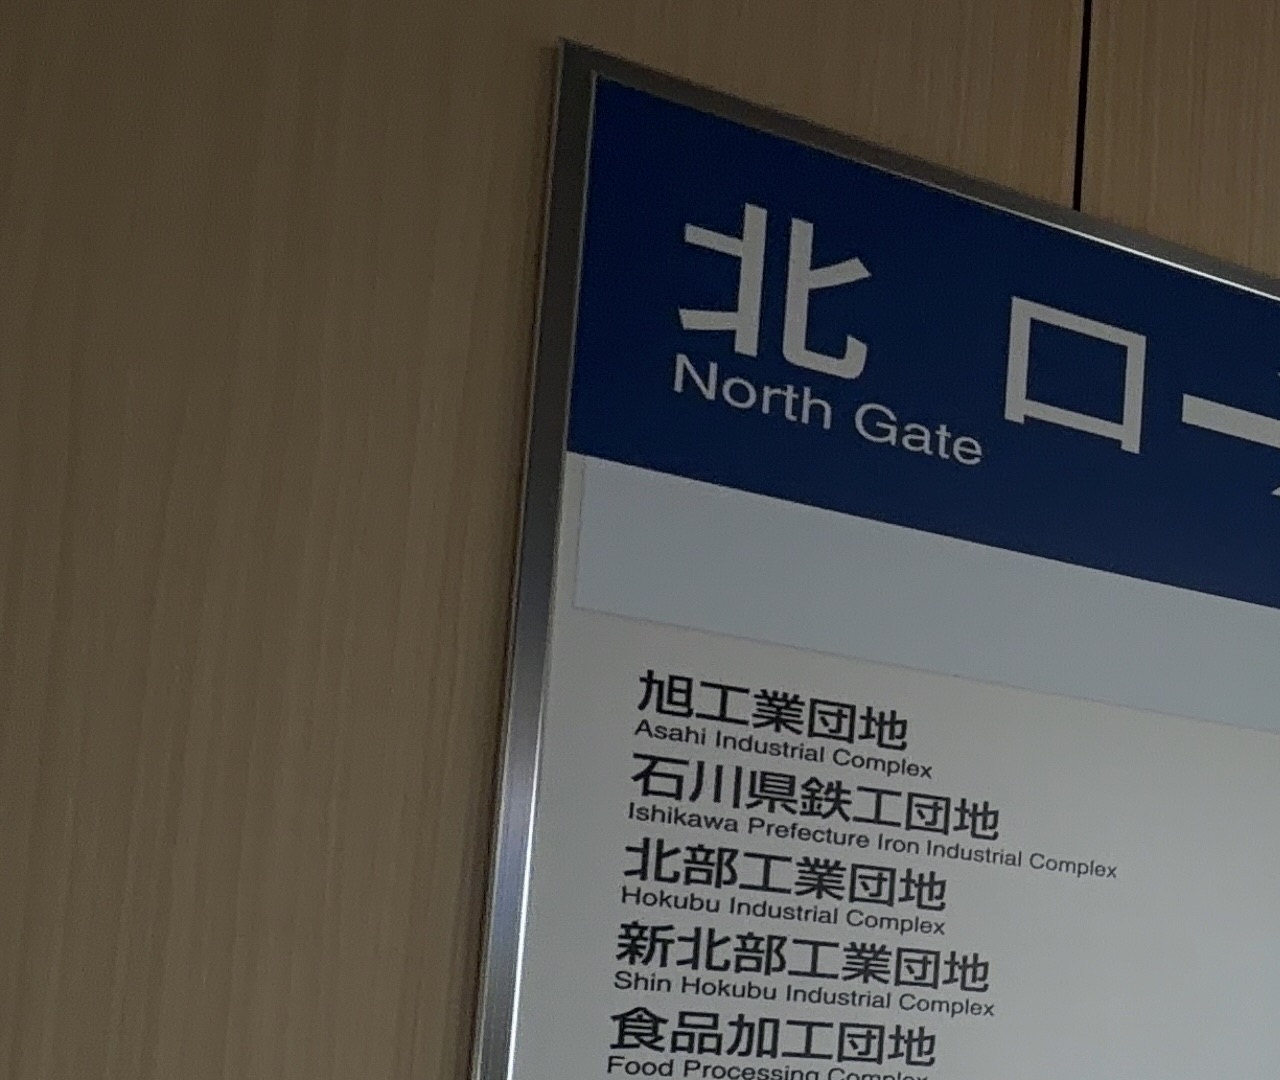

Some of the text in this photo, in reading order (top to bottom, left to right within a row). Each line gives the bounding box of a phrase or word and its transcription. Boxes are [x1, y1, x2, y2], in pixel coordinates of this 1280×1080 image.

[674, 353, 982, 465] North Gate
[637, 669, 908, 752] 旭工業団地
[634, 718, 933, 780] Asahi Industrial Complex
[630, 752, 999, 841] 石川県鉄工団地
[623, 836, 947, 912] 北部工業団地
[628, 801, 1117, 879] Ishikawa Prefecture Iron Industrial Complex
[621, 885, 945, 936] Hokubu Industrial Complex
[615, 920, 989, 993] 新北部工業団地
[613, 970, 995, 1019] Shin Hokubu Industrial Complex
[606, 1055, 675, 1077] Food
[609, 1006, 936, 1067] 食品加工団地
